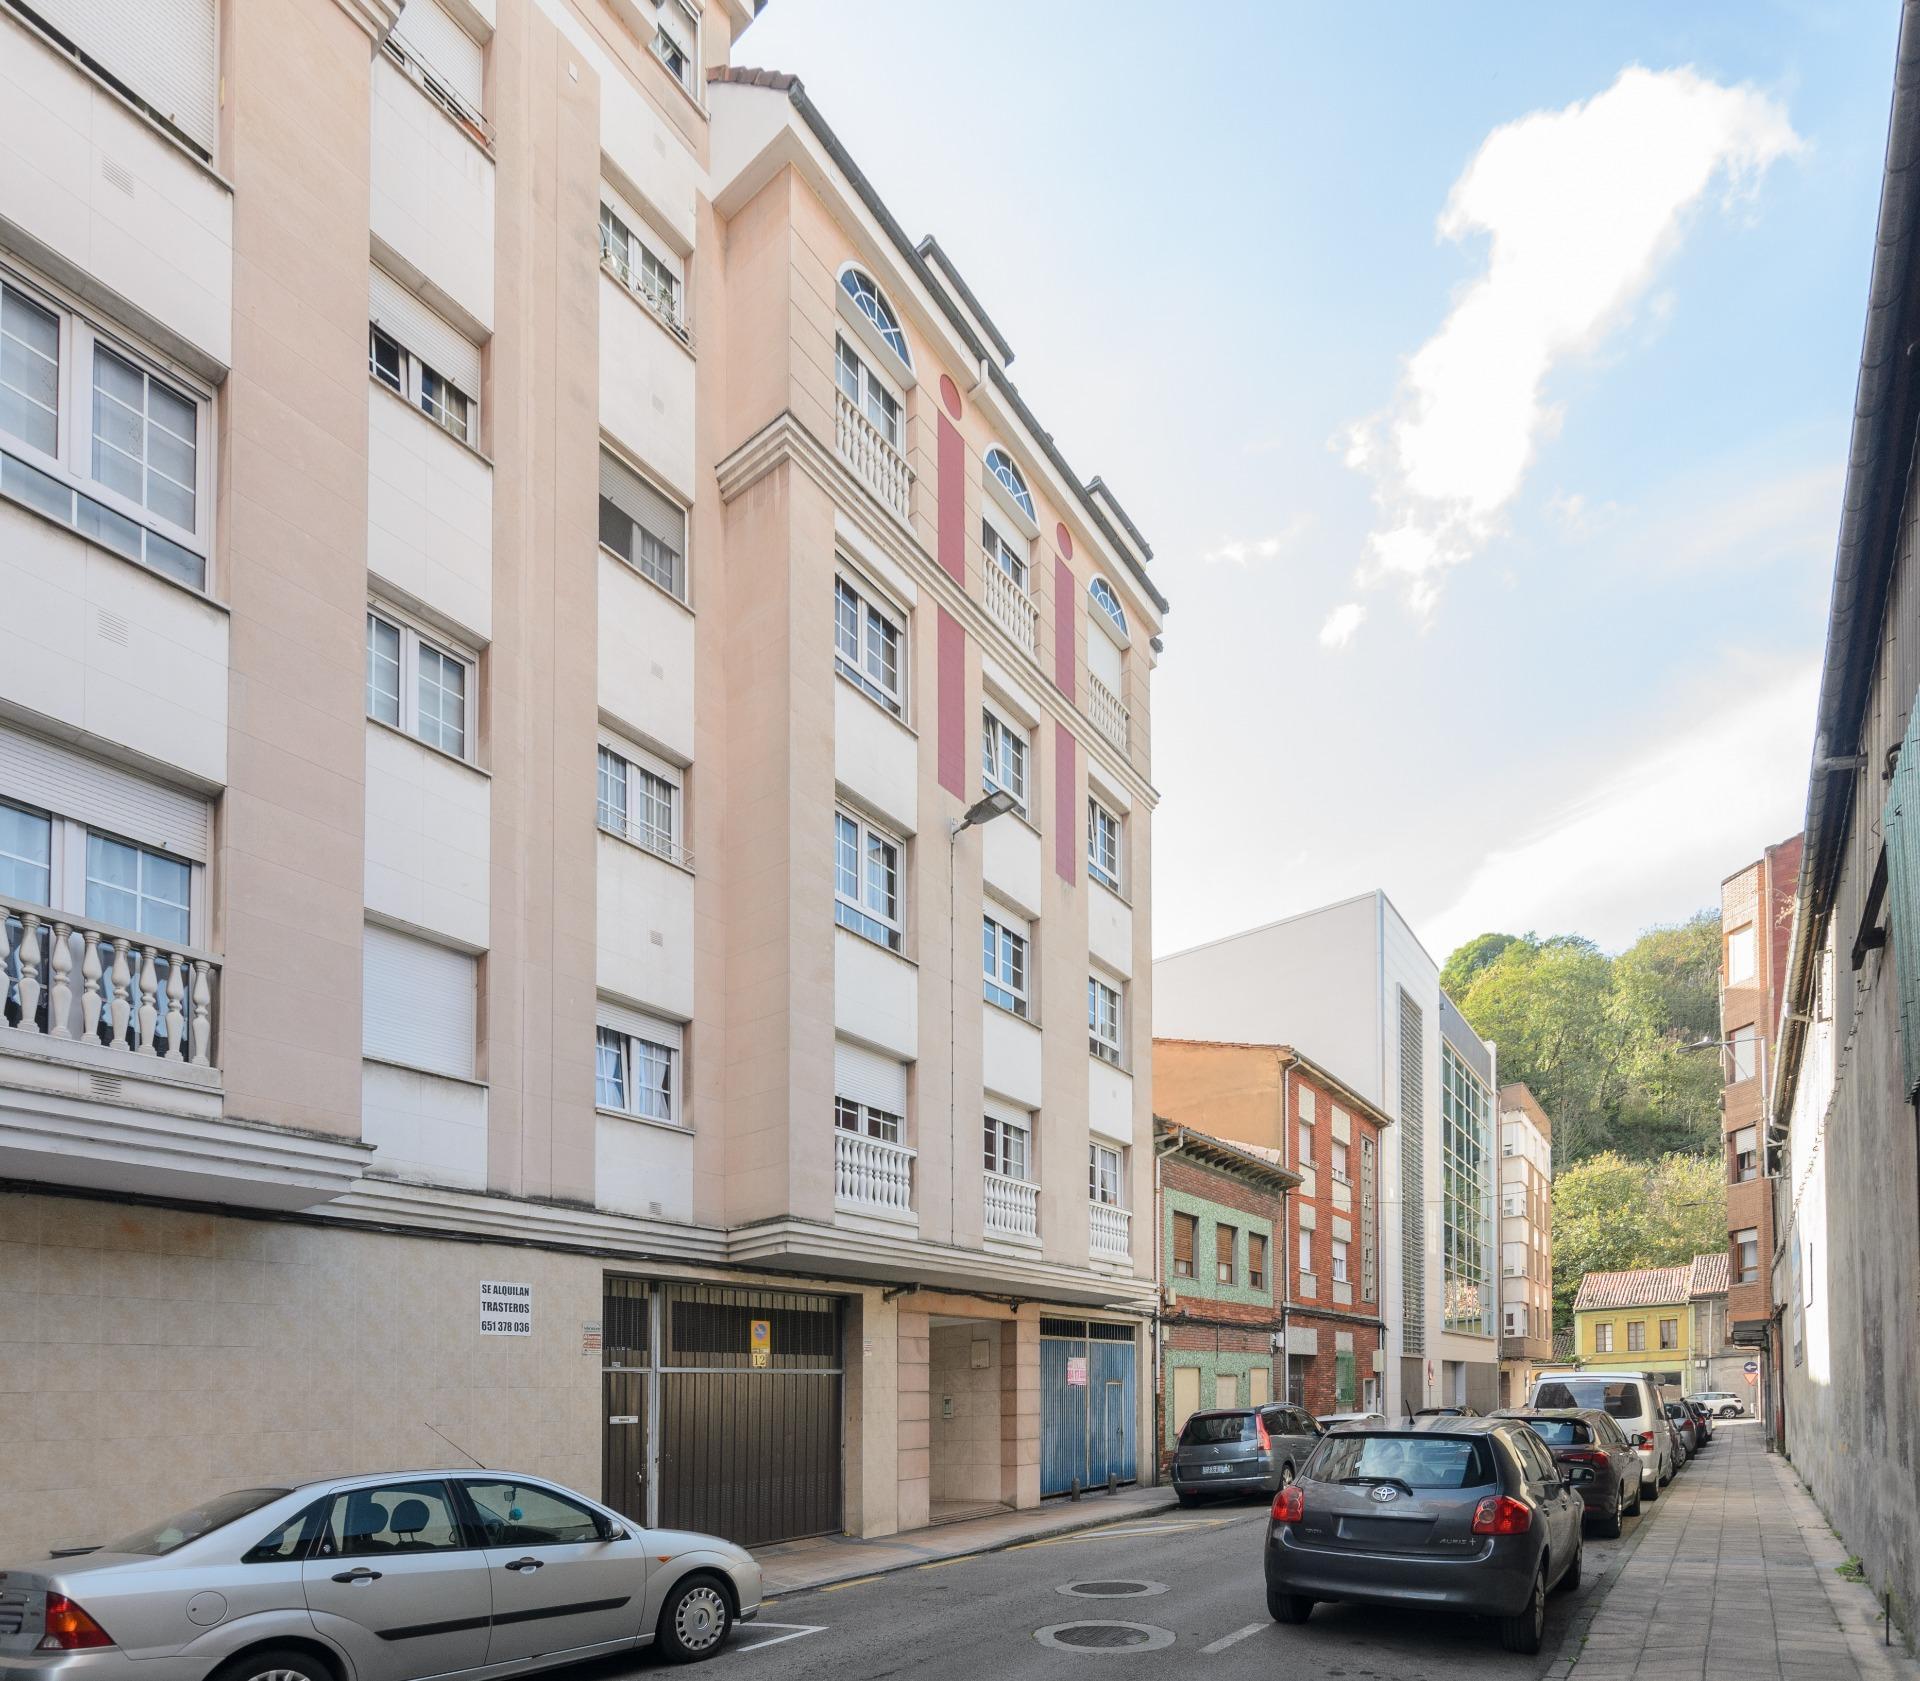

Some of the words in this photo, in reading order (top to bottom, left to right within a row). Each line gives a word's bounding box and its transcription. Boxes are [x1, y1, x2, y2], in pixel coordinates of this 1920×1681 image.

[481, 1284, 491, 1294] SE
[493, 1285, 530, 1296] ALQUILAN
[481, 1301, 530, 1314] TRASTEROS
[481, 1320, 496, 1332] 651
[497, 1321, 513, 1332] 378
[514, 1321, 530, 1333] 036
[754, 1355, 765, 1365] 12
